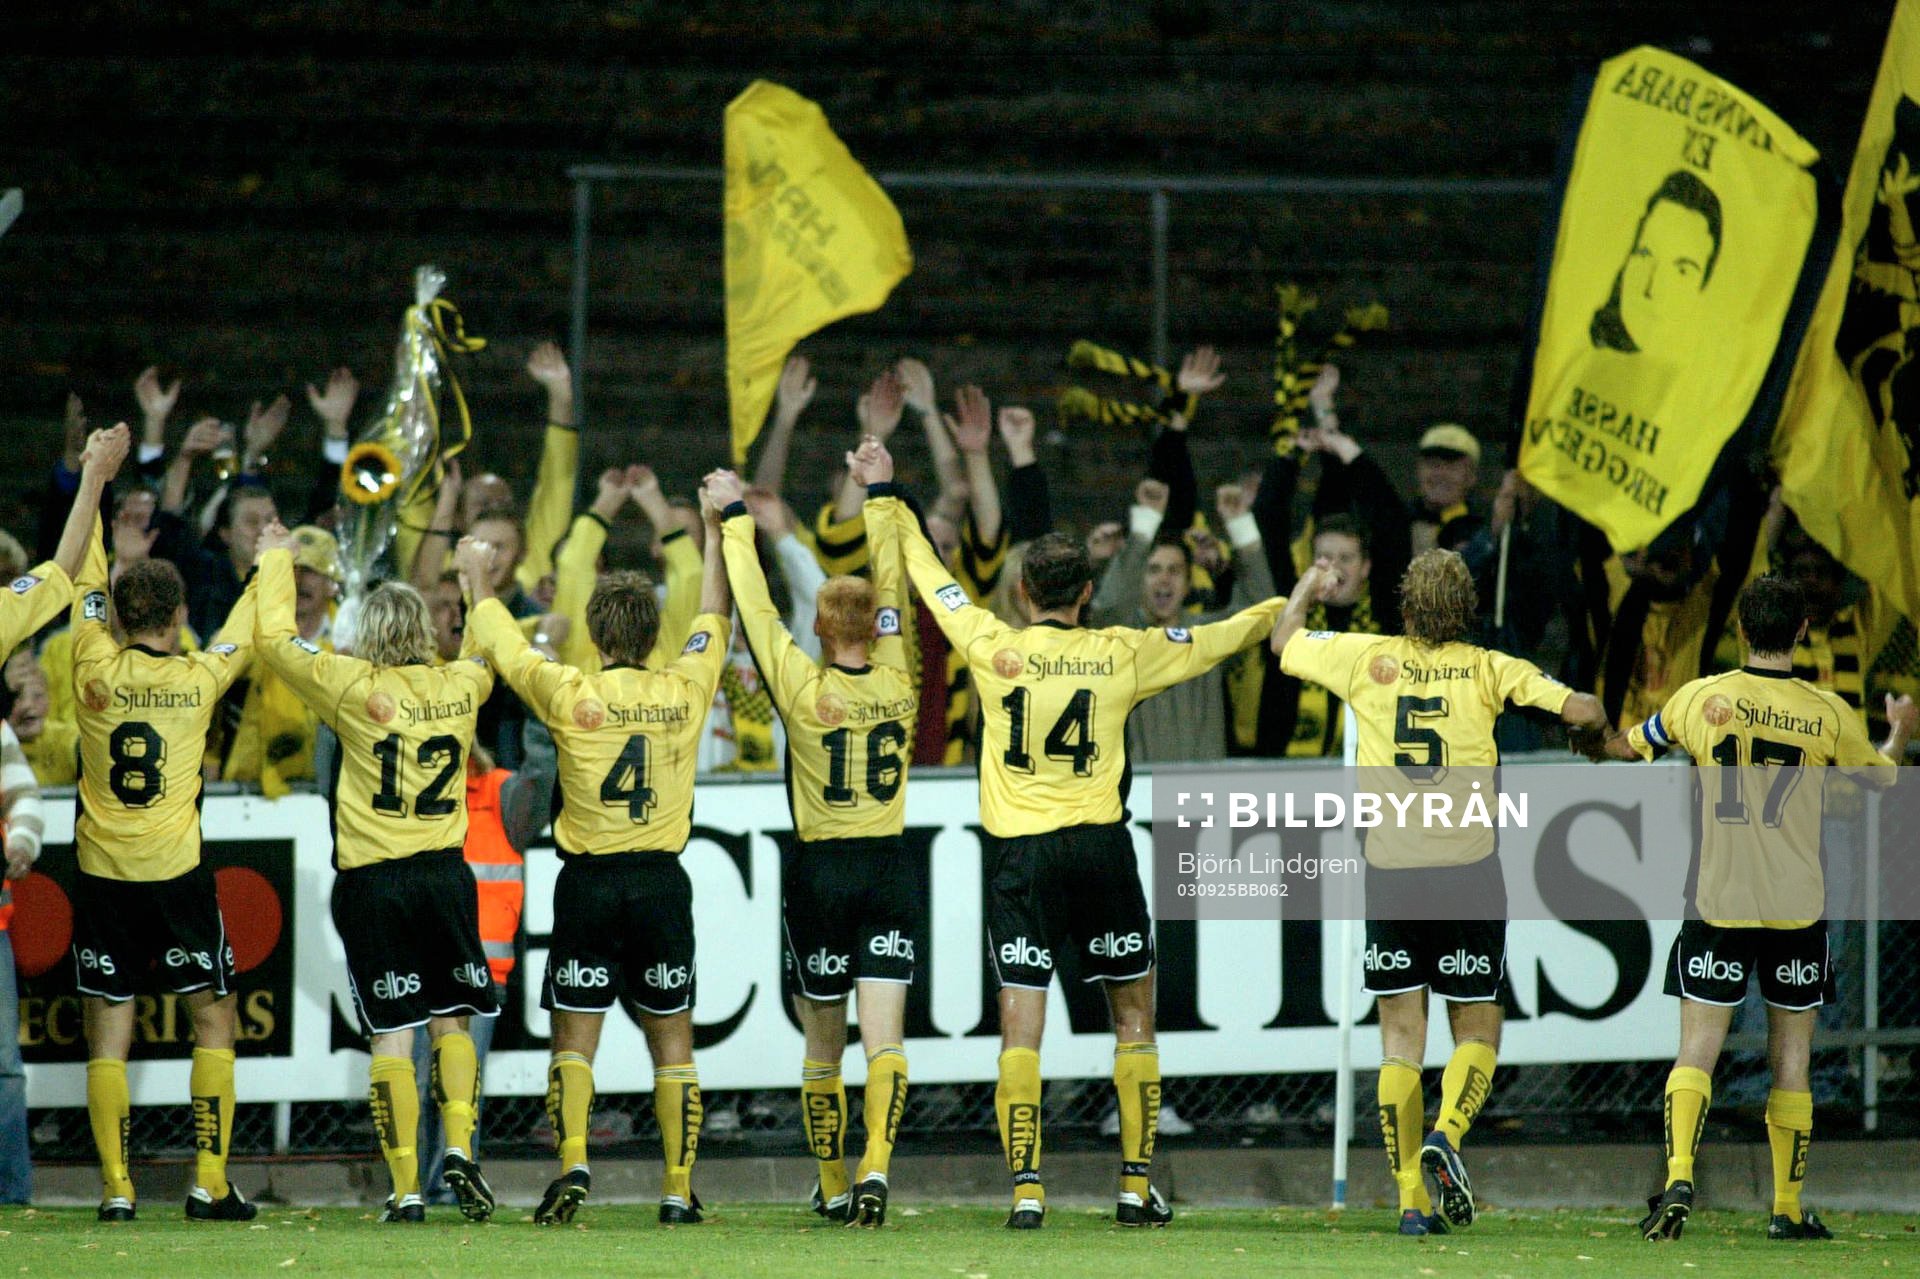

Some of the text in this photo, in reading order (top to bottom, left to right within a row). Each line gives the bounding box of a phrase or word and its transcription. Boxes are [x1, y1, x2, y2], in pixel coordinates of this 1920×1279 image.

[1027, 653, 1113, 680] Sjuhärad
[114, 687, 200, 712] Sjuhärad
[400, 693, 473, 726] Sjuhärad
[607, 701, 690, 725] Sjuhärad
[1002, 686, 1099, 777] 14
[1735, 699, 1823, 737] Sjuhärad
[1394, 695, 1449, 786] 5
[109, 721, 167, 809] 8
[372, 732, 462, 820] 12
[600, 734, 657, 825] 4
[822, 720, 906, 807] 16
[1713, 734, 1806, 829] 17
[1001, 937, 1053, 969] ellos
[1089, 932, 1143, 958] ellos
[1438, 949, 1491, 976] ellos
[556, 959, 609, 988] ellos
[645, 962, 687, 990] ellos
[1688, 950, 1744, 982] ellos
[1776, 958, 1819, 986] ellos
[373, 971, 421, 999] ellos
[1461, 1072, 1488, 1118] Offic
[192, 1099, 218, 1149] Offic
[810, 1096, 839, 1158] Office
[1012, 1106, 1035, 1171] Office
